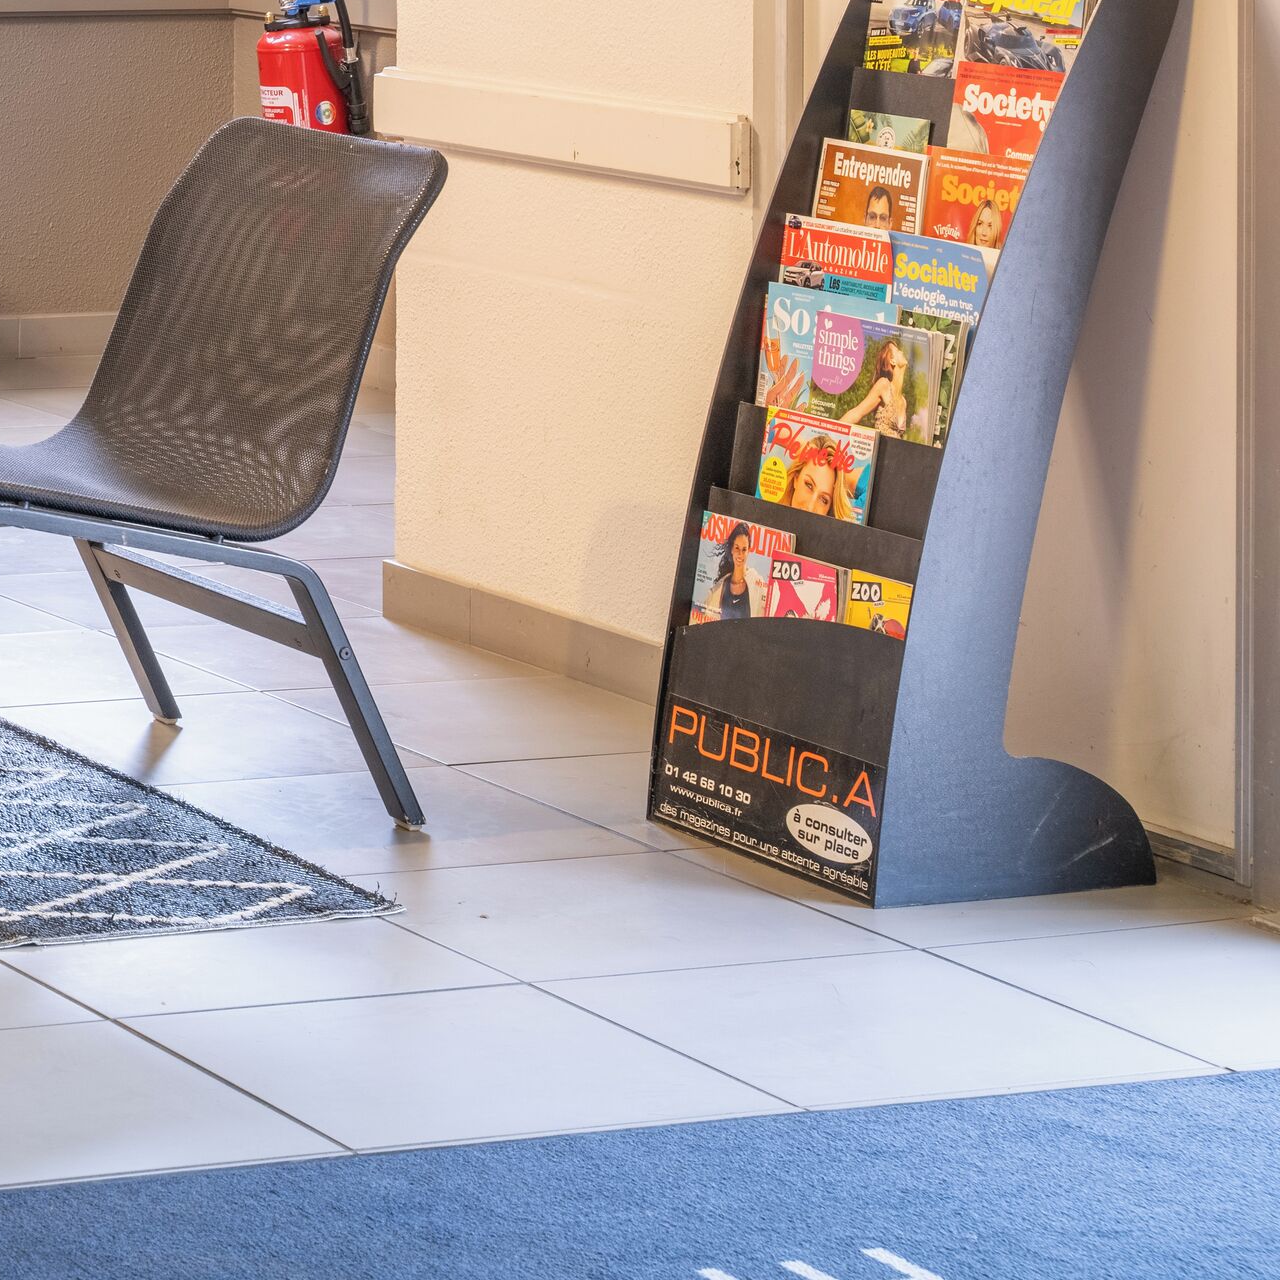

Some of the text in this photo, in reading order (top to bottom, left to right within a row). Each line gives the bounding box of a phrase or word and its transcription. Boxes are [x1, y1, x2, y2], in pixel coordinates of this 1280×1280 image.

[867, 50, 877, 60] LES
[962, 83, 1056, 132] Society
[834, 151, 911, 189] Entreprendre
[941, 174, 1020, 213] Societ
[934, 223, 960, 239] Virginie
[789, 229, 889, 274] L'Automobile
[823, 266, 858, 277] AGAZINE
[829, 276, 840, 290] Les
[894, 252, 978, 293] Socialter
[893, 281, 973, 311] L'écologie, un truc
[924, 303, 980, 326] bourgeois?
[819, 329, 859, 354] simple
[818, 345, 856, 376] things
[769, 422, 828, 467] Pleine
[831, 439, 855, 473] Vie
[701, 514, 792, 558] COSMOLITAN
[772, 561, 800, 579] ZOO
[852, 582, 880, 601] ZOO
[668, 705, 876, 817] PUBLIC.A
[665, 763, 751, 805] 01 42 68 10 30
[670, 784, 743, 817] www.publica.fr
[793, 808, 868, 847] à consulter
[660, 800, 869, 891] des magazines pour une attente agréable
[797, 829, 859, 860] sur place
